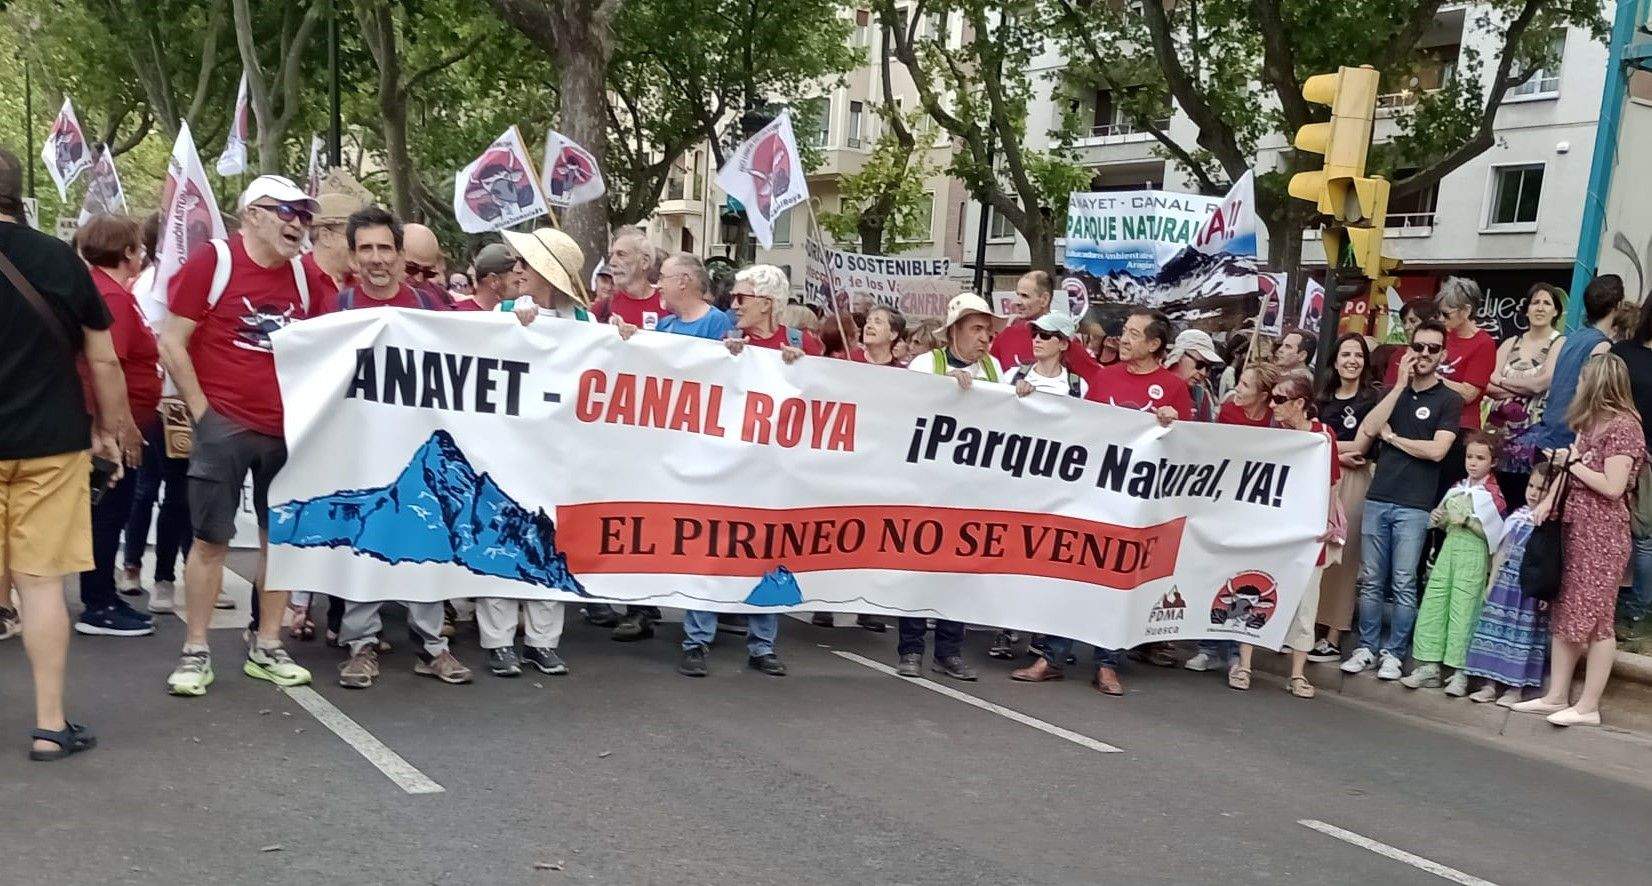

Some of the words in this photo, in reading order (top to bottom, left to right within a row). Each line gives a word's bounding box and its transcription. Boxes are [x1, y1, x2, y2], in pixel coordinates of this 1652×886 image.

[1132, 196, 1195, 213] CANAL
[1067, 215, 1117, 246] PARQUE
[847, 257, 950, 277] SOSTENIBLE?
[866, 276, 884, 291] los
[346, 345, 530, 417] ANAYET
[575, 368, 726, 438] CANAL
[740, 390, 858, 453] ROYA
[906, 414, 1089, 483] ¡Parque
[1095, 443, 1231, 502] Natural,
[1234, 460, 1291, 508] YA!
[598, 516, 655, 556] EL
[671, 517, 866, 560] PIRINEO
[876, 518, 945, 556] NO
[955, 522, 1009, 558] SE
[1020, 524, 1159, 574] VENDE
[1149, 608, 1184, 622] PDMA
